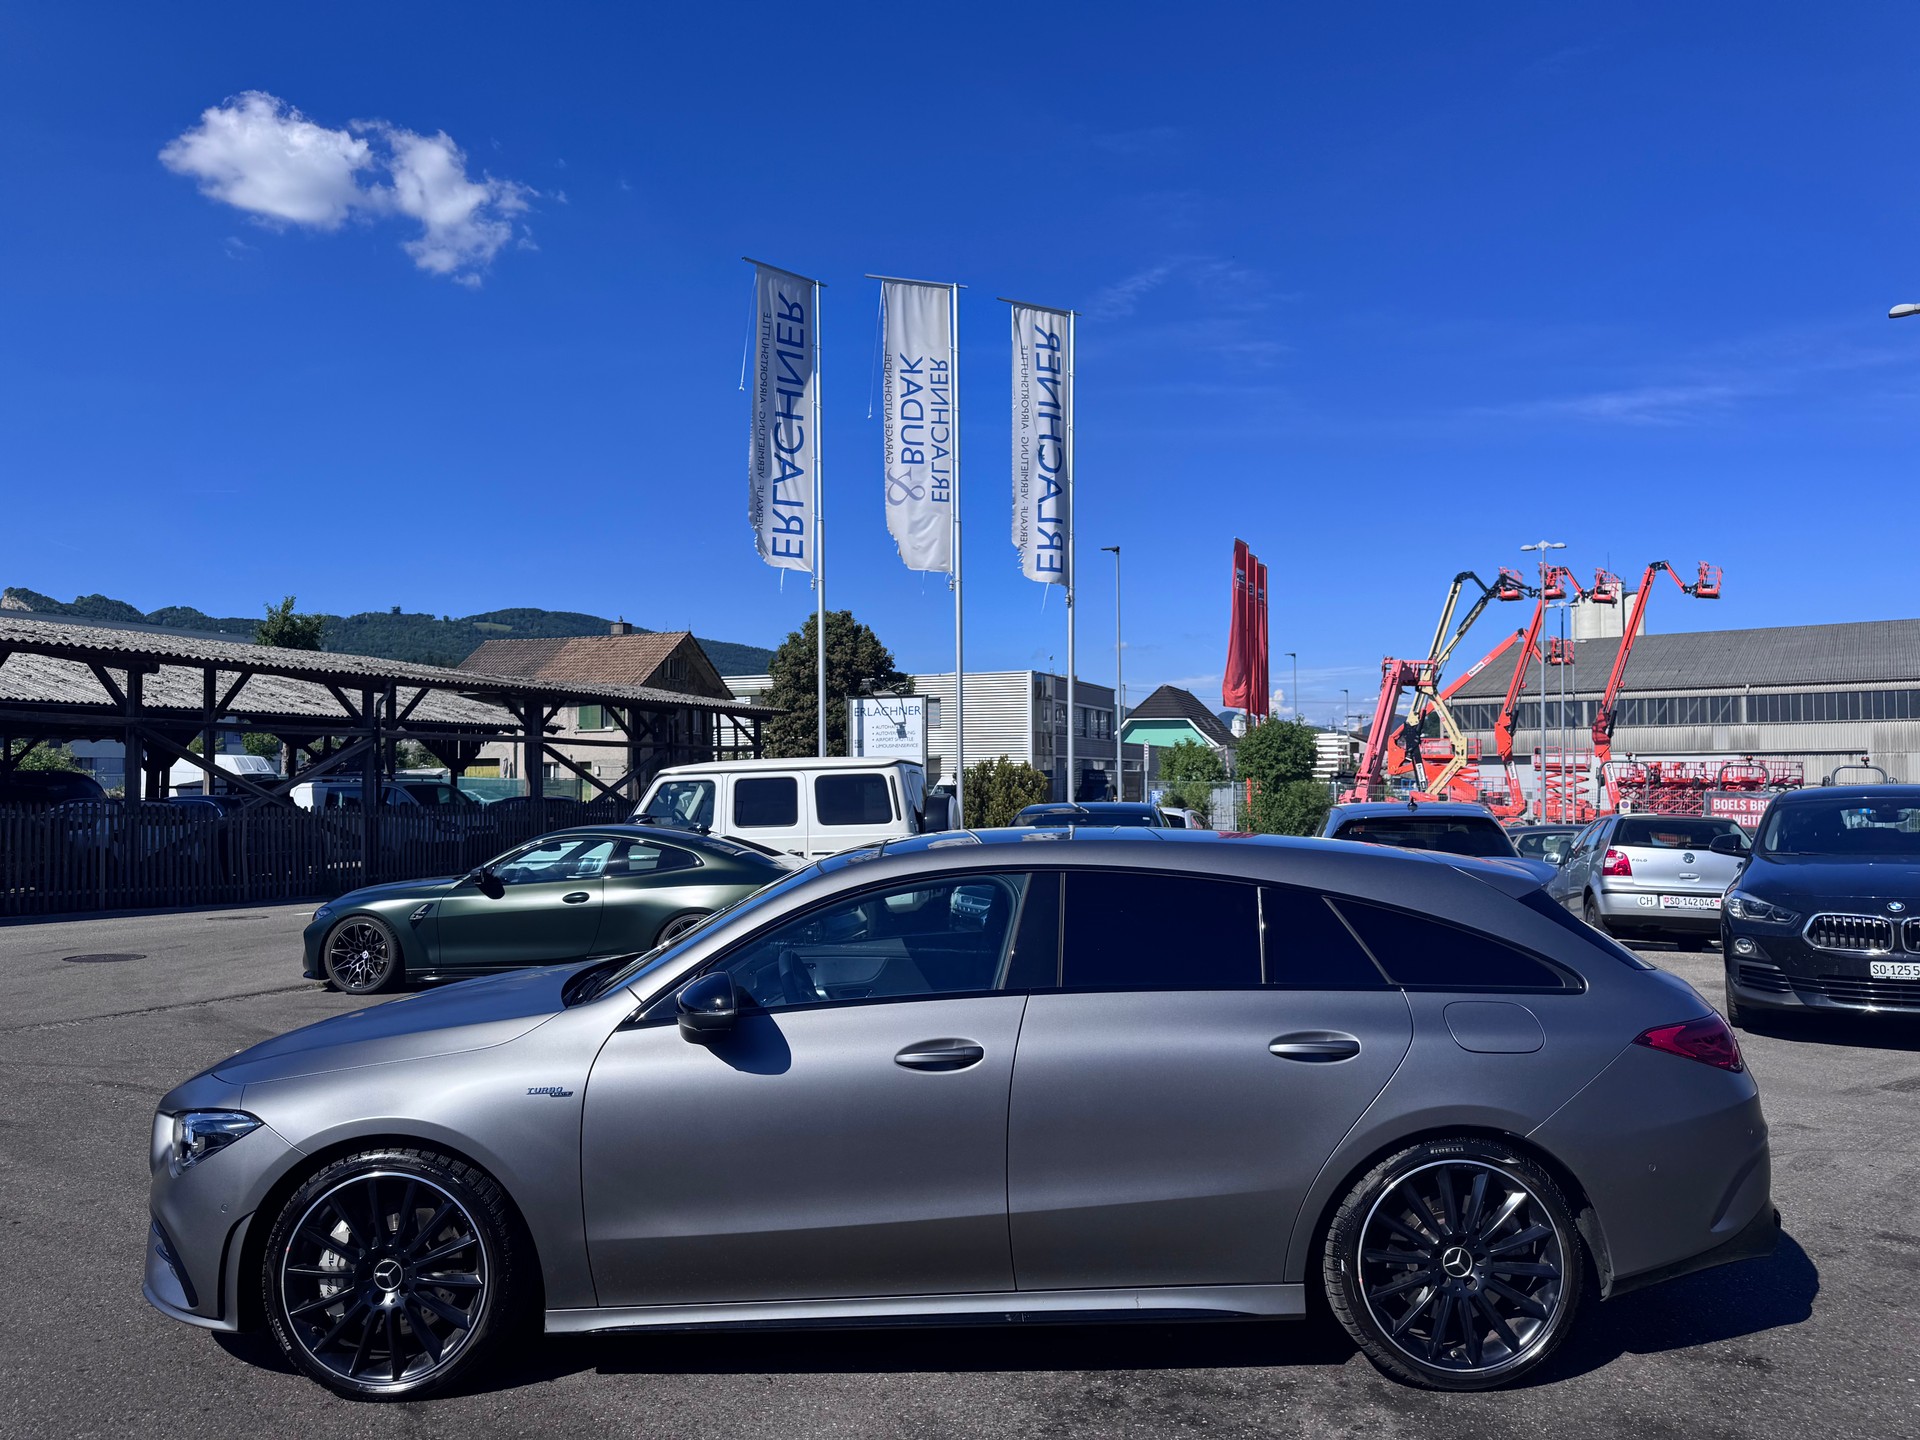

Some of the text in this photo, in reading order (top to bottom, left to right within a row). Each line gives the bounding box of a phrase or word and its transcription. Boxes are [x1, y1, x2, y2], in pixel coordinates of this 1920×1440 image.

[854, 705, 922, 717] ERLACHNER
[1713, 799, 1747, 811] BOELS
[1639, 896, 1653, 906] CH
